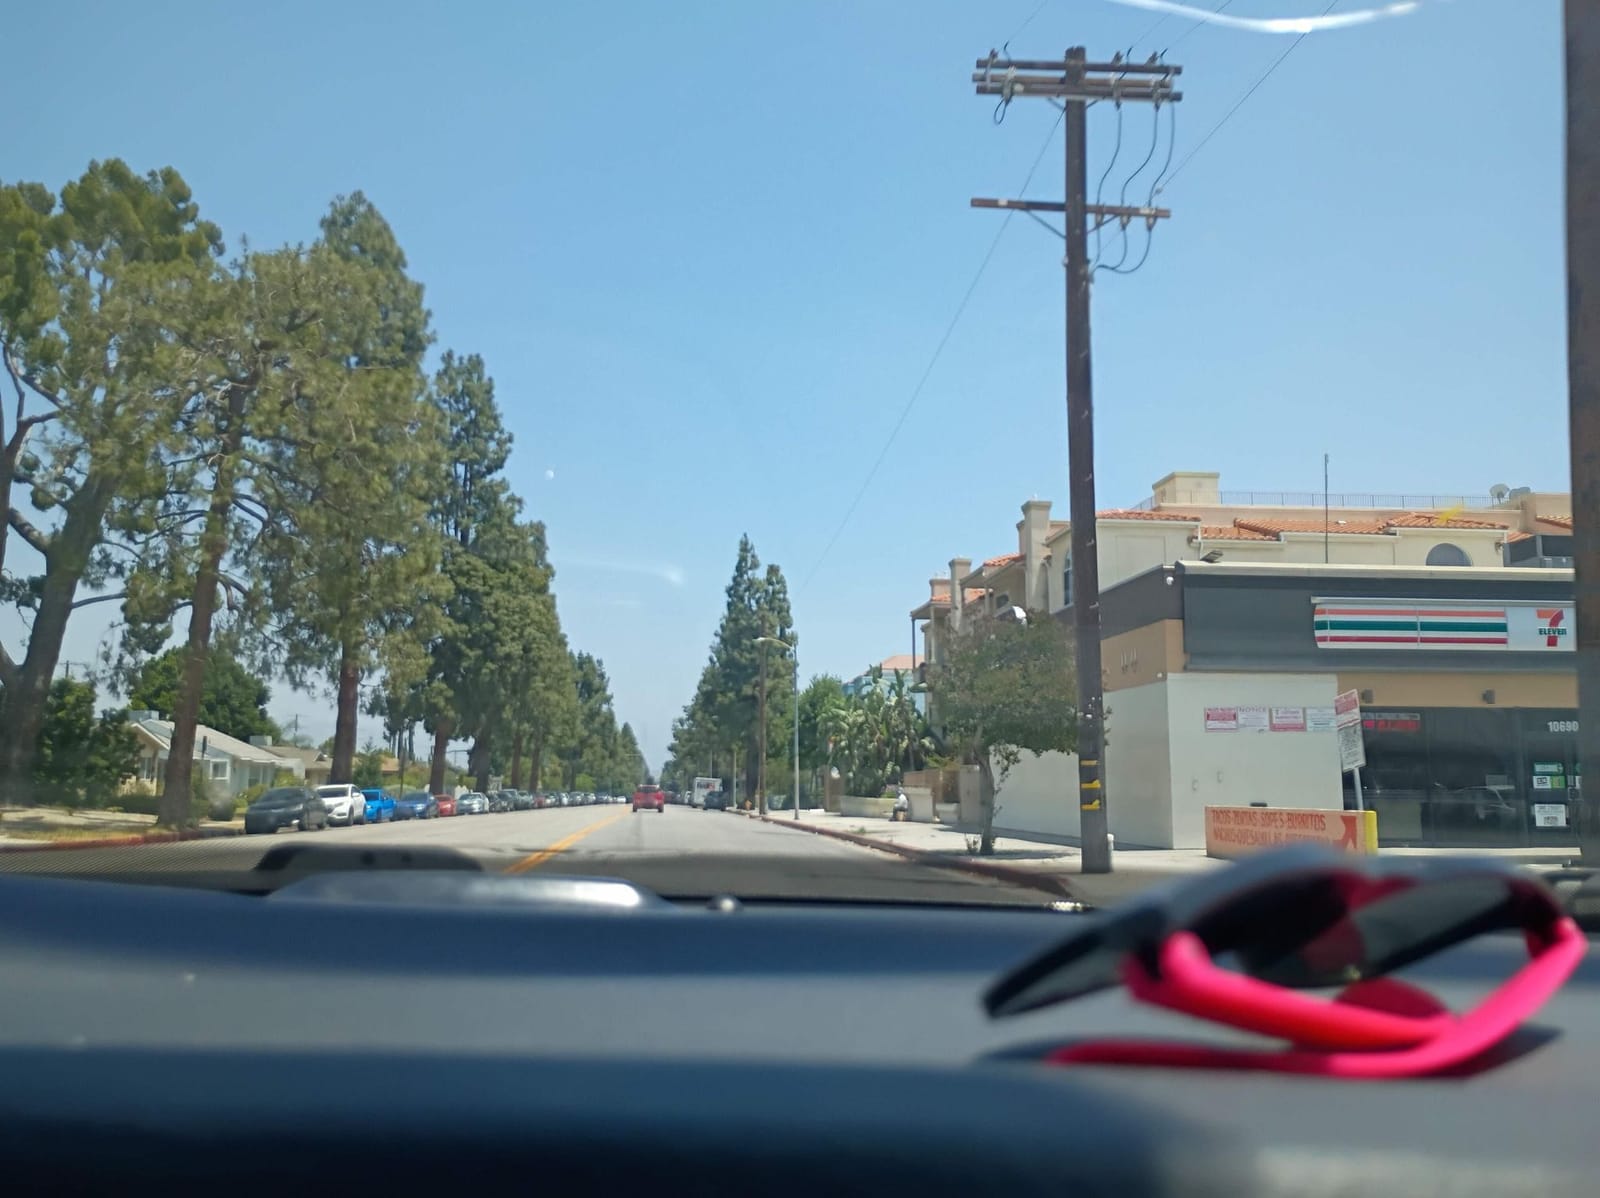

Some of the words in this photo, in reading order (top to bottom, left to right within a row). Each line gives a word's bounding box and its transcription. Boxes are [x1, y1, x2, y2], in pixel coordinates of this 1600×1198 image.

[1536, 608, 1564, 648] 7
[1547, 720, 1580, 733] 10690
[1286, 812, 1326, 832] BURRITOS
